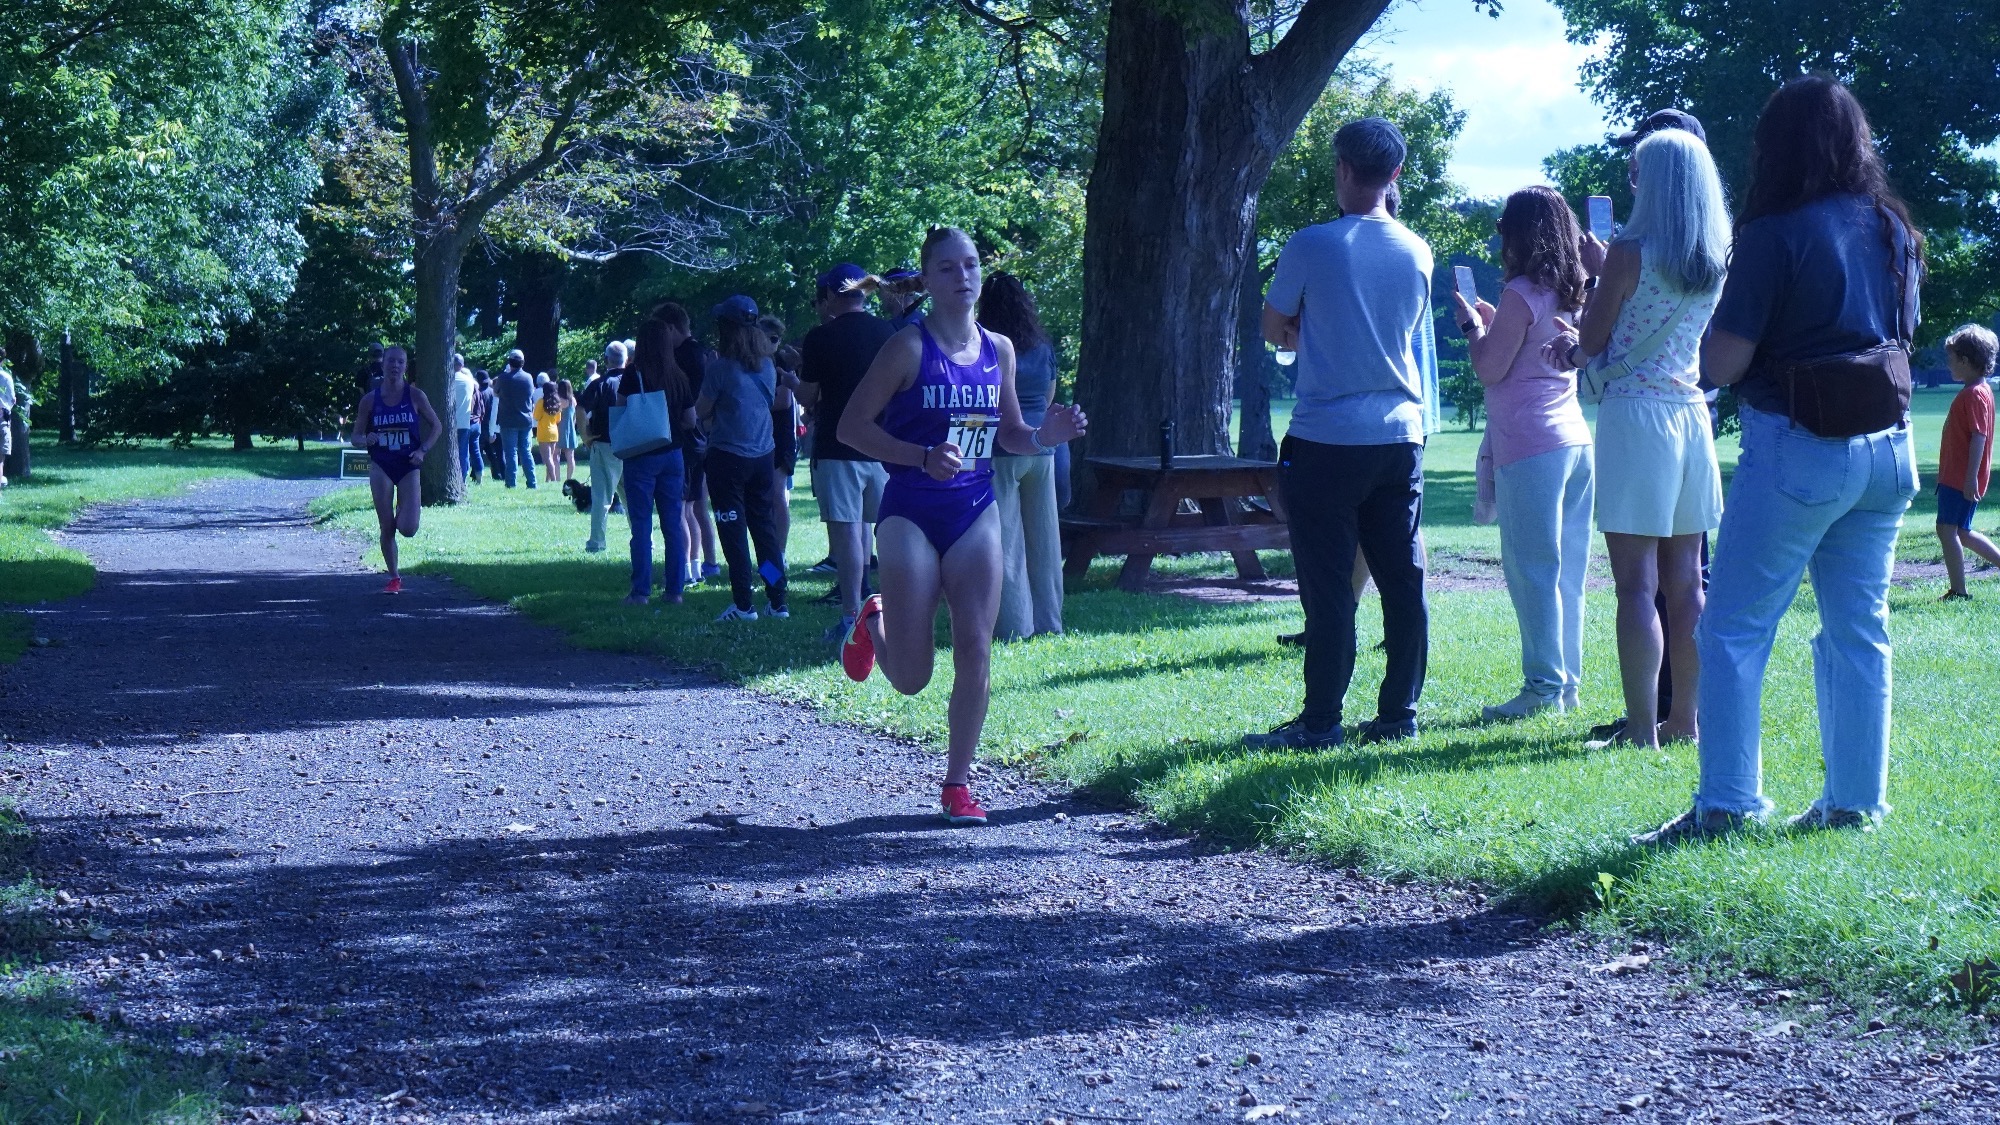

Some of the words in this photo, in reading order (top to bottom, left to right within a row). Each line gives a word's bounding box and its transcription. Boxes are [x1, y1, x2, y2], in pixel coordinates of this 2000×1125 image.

[373, 412, 414, 426] NIAGARA
[384, 431, 404, 445] 170
[956, 427, 988, 458] 176
